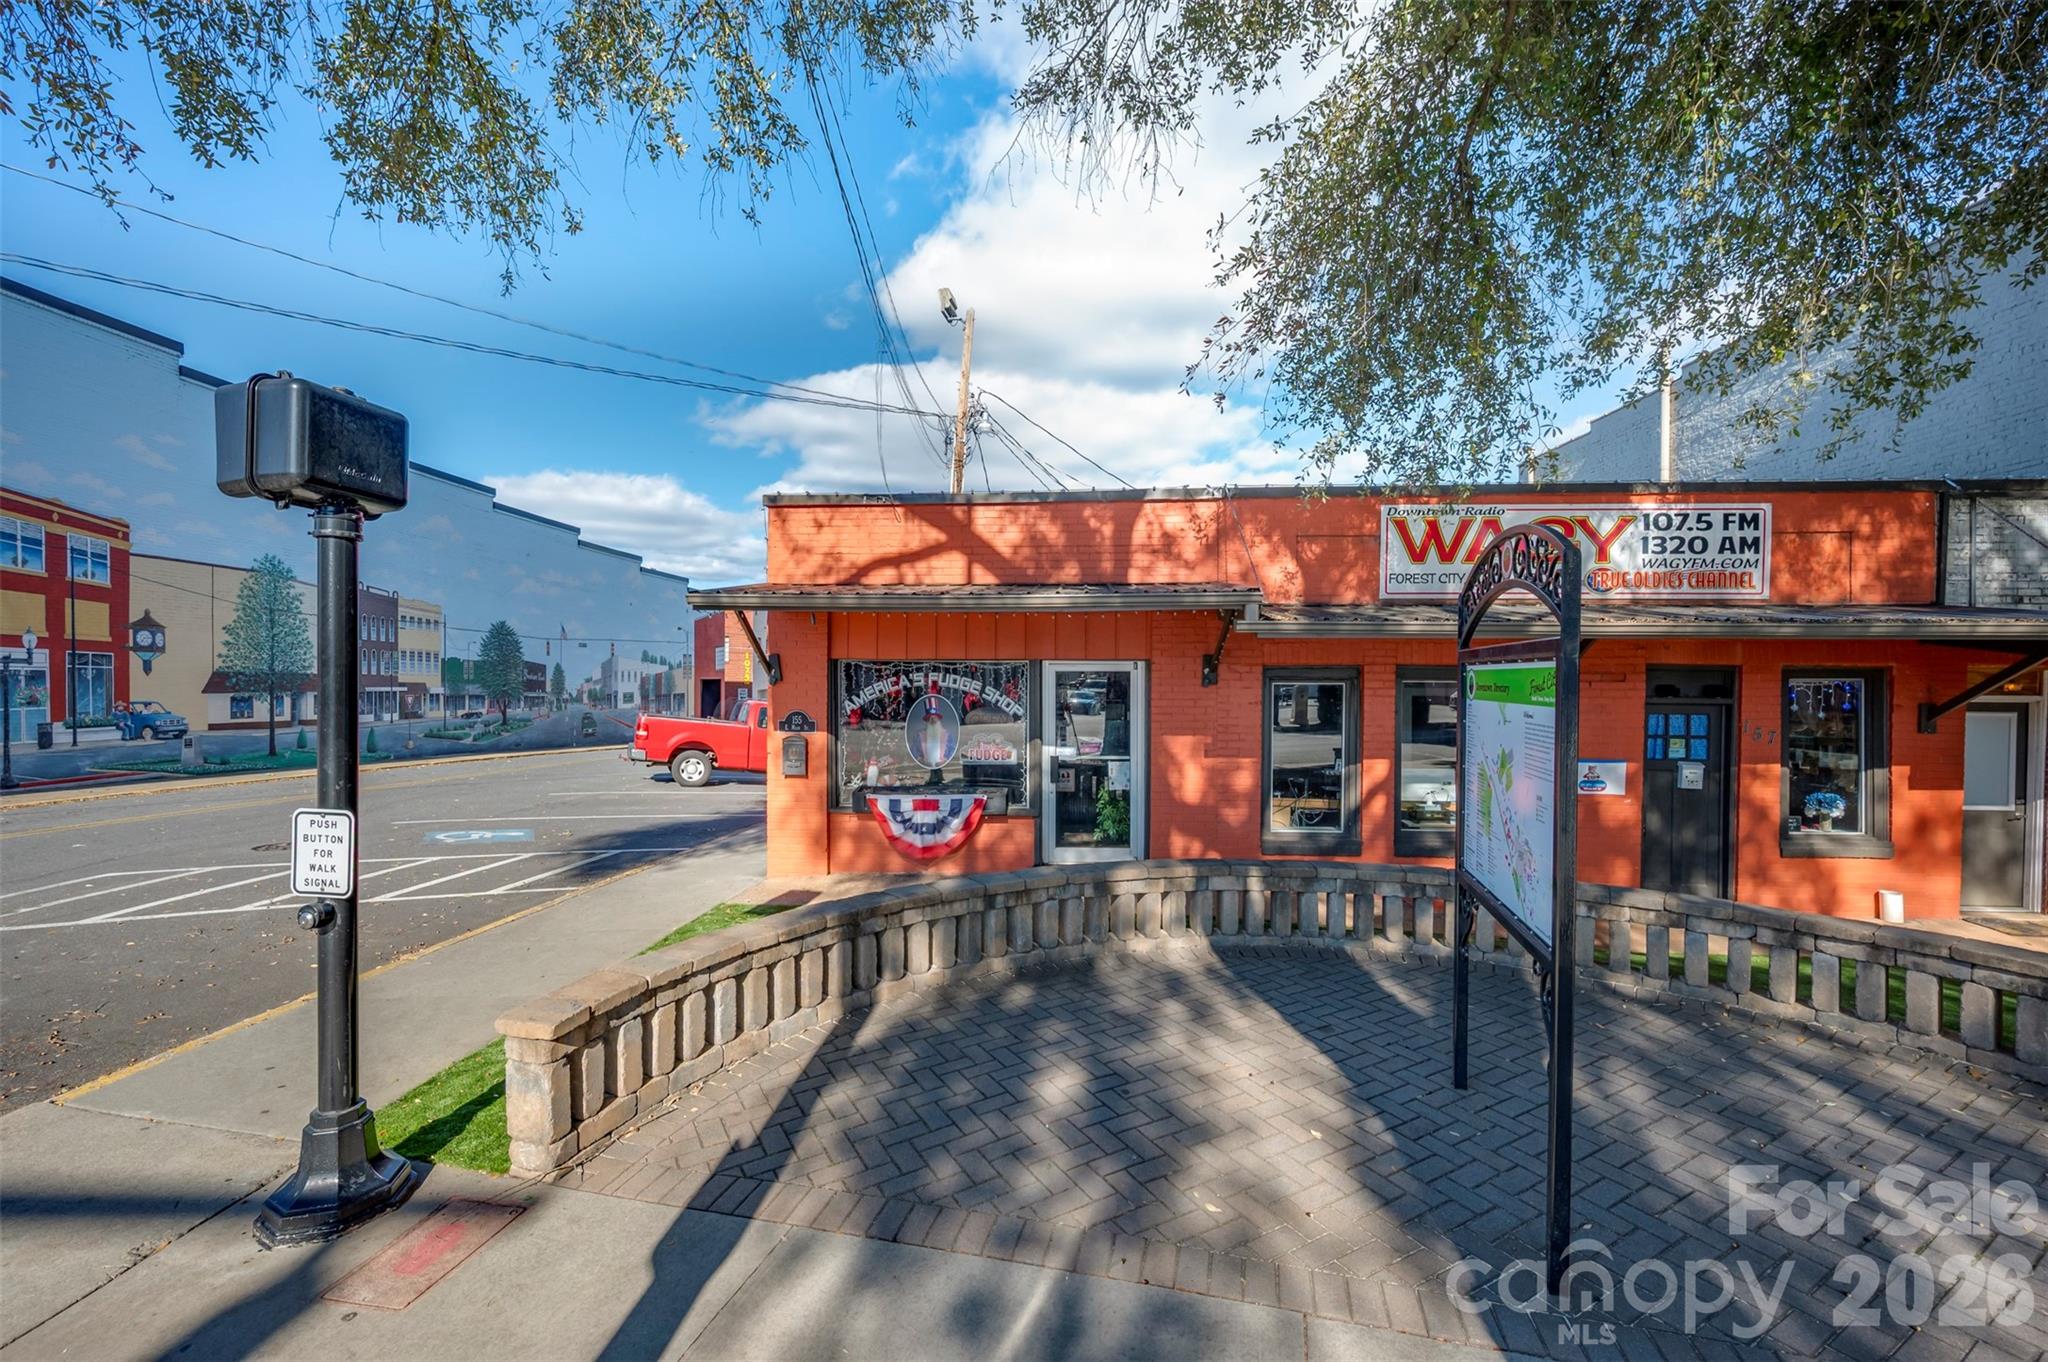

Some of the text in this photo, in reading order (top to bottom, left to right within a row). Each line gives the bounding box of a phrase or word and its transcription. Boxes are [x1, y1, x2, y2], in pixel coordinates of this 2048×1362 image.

[1464, 506, 1506, 517] Radio
[1641, 512, 1761, 532] 107.5 FM
[1639, 535, 1761, 556] 1320 AM
[1388, 572, 1437, 585] FOREST
[1591, 569, 1757, 591] TRUE OLDIES CHANNEL
[843, 672, 924, 716] AMERICA'S
[928, 671, 983, 696] FUDGE
[981, 687, 1025, 718] SHOP
[309, 819, 337, 829] PUSH
[303, 834, 343, 844] BUTTON
[313, 849, 333, 858] FOR
[309, 864, 336, 873] WALK
[303, 878, 341, 889] SIGNAL
